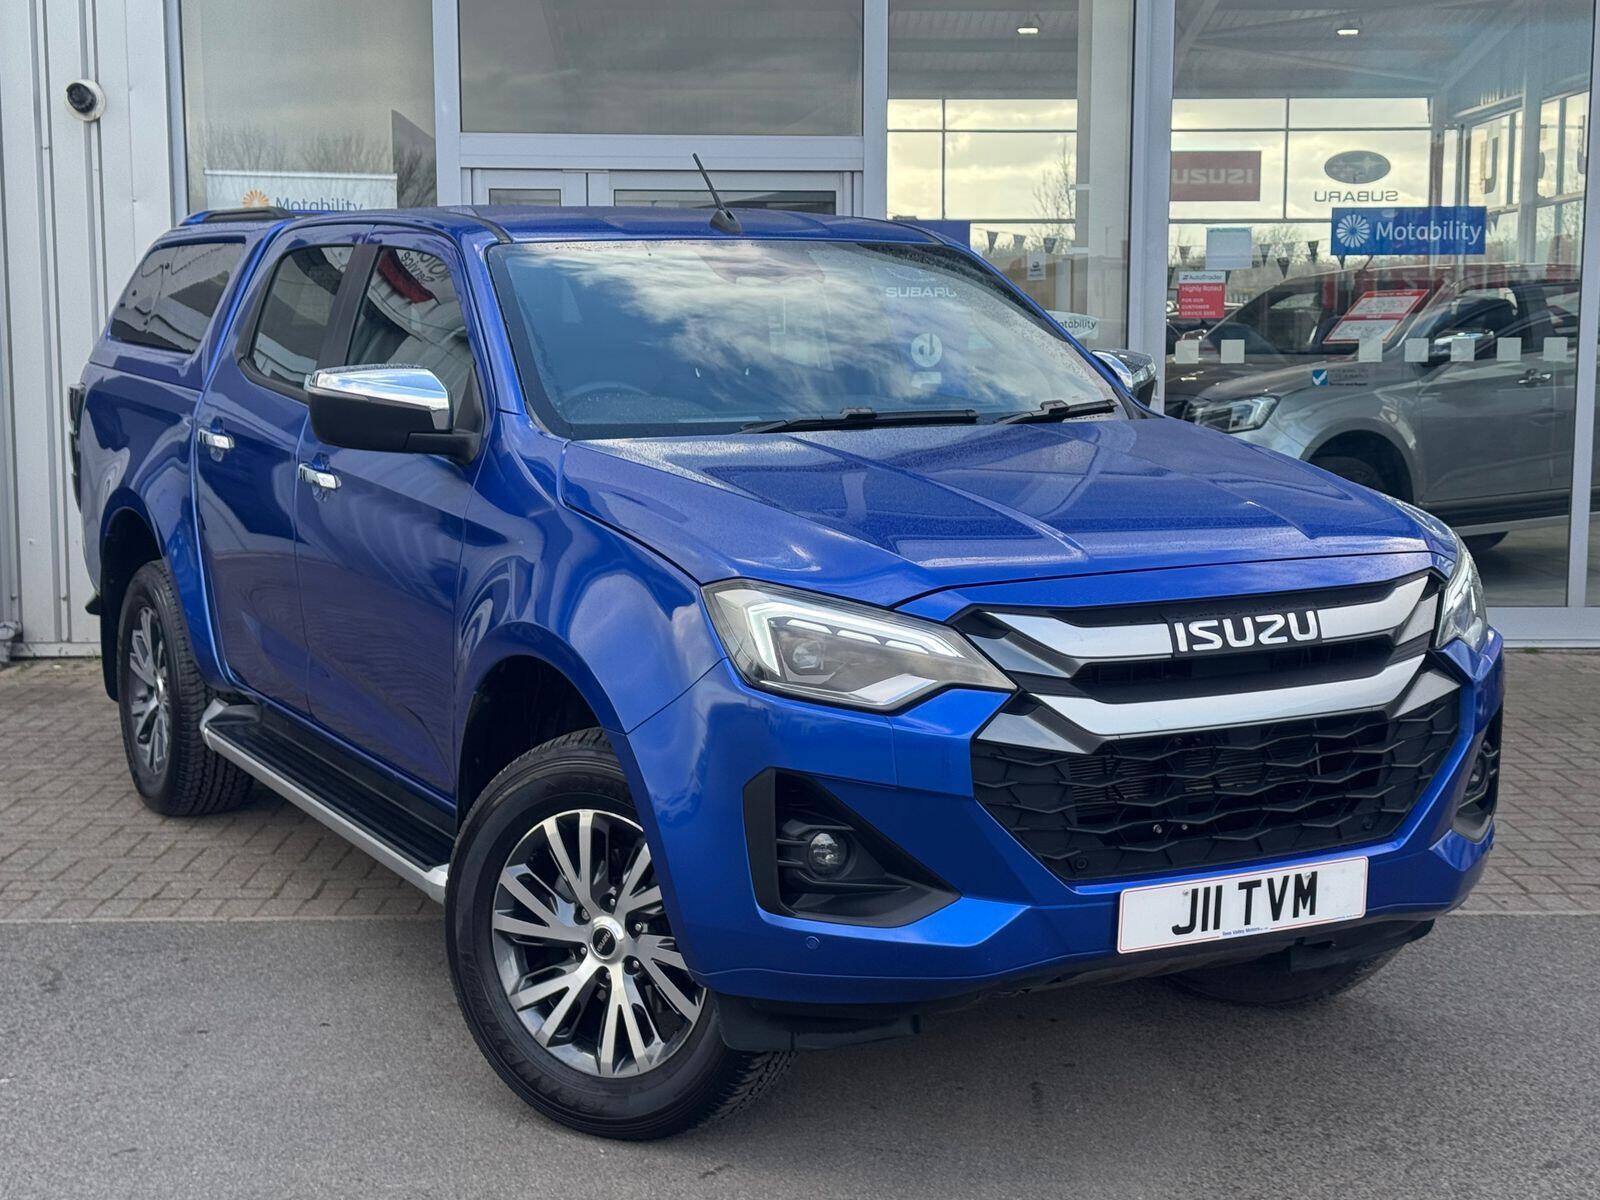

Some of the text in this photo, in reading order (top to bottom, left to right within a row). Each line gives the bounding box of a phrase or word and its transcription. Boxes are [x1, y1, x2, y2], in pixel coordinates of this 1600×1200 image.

[1375, 220, 1482, 245] Motability
[1059, 320, 1097, 329] otability
[1174, 610, 1318, 652] ISUZU
[1171, 871, 1318, 936] J11 TVM
